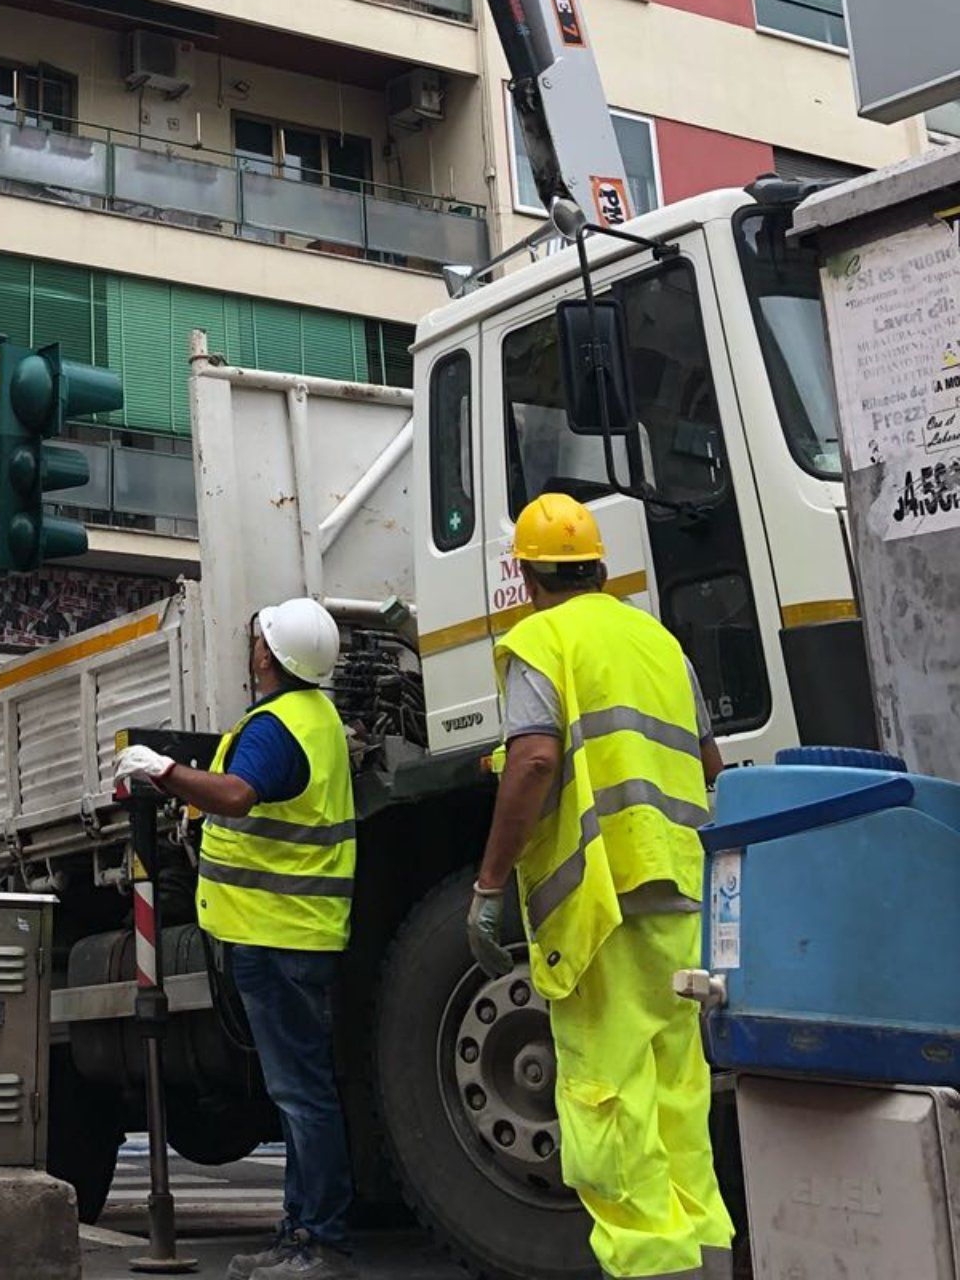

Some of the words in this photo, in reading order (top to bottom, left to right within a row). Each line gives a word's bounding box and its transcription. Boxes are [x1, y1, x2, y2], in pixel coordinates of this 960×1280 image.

[563, 22, 579, 38] 7
[708, 695, 734, 719] L6
[441, 712, 484, 733] VOLVO
